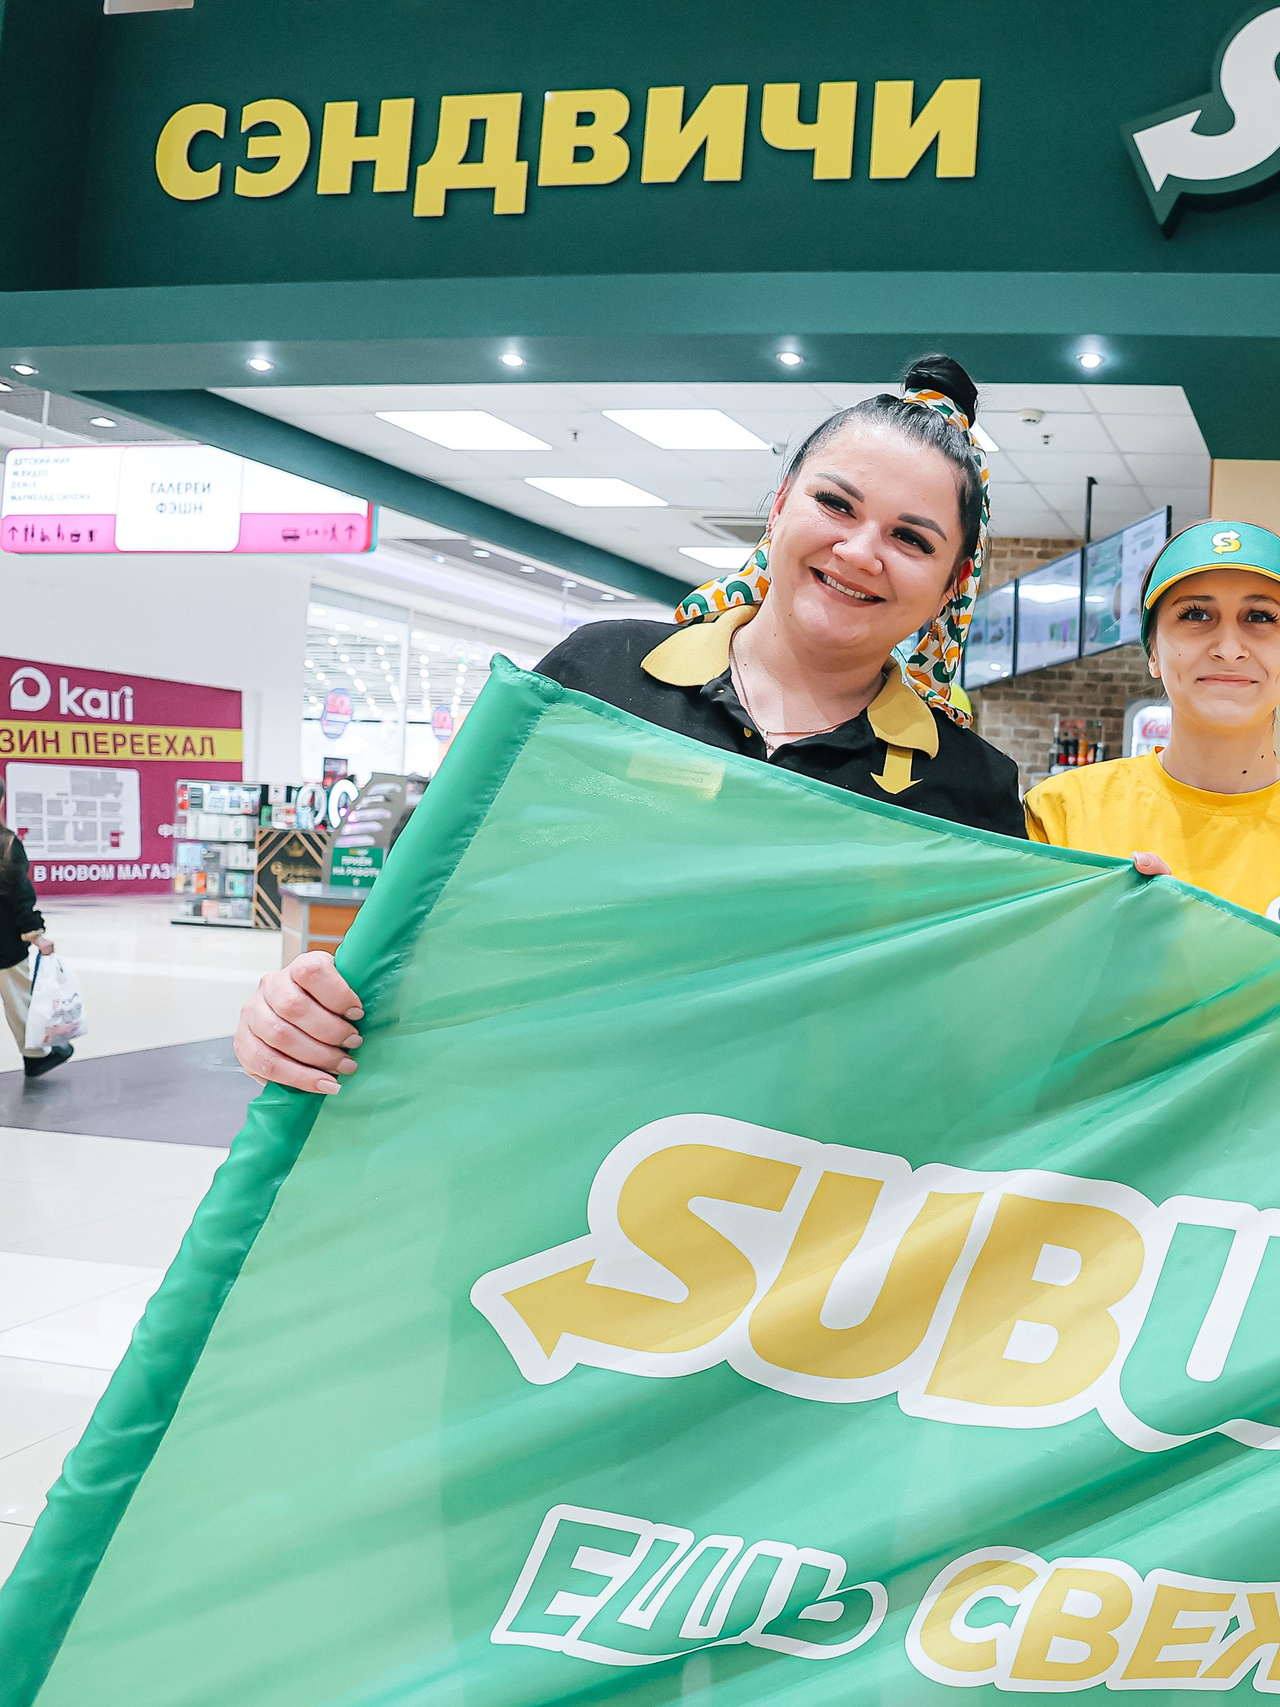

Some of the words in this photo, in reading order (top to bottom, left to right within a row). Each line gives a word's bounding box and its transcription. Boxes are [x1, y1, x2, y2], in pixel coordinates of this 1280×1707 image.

[150, 482, 212, 495] ГАЛЕРЕИ
[156, 501, 204, 515] ФЭШН
[59, 677, 134, 722] kari
[72, 731, 217, 757] ПЕРЕЕХАЛ
[33, 864, 47, 882] В
[51, 863, 115, 882] НОВОМ
